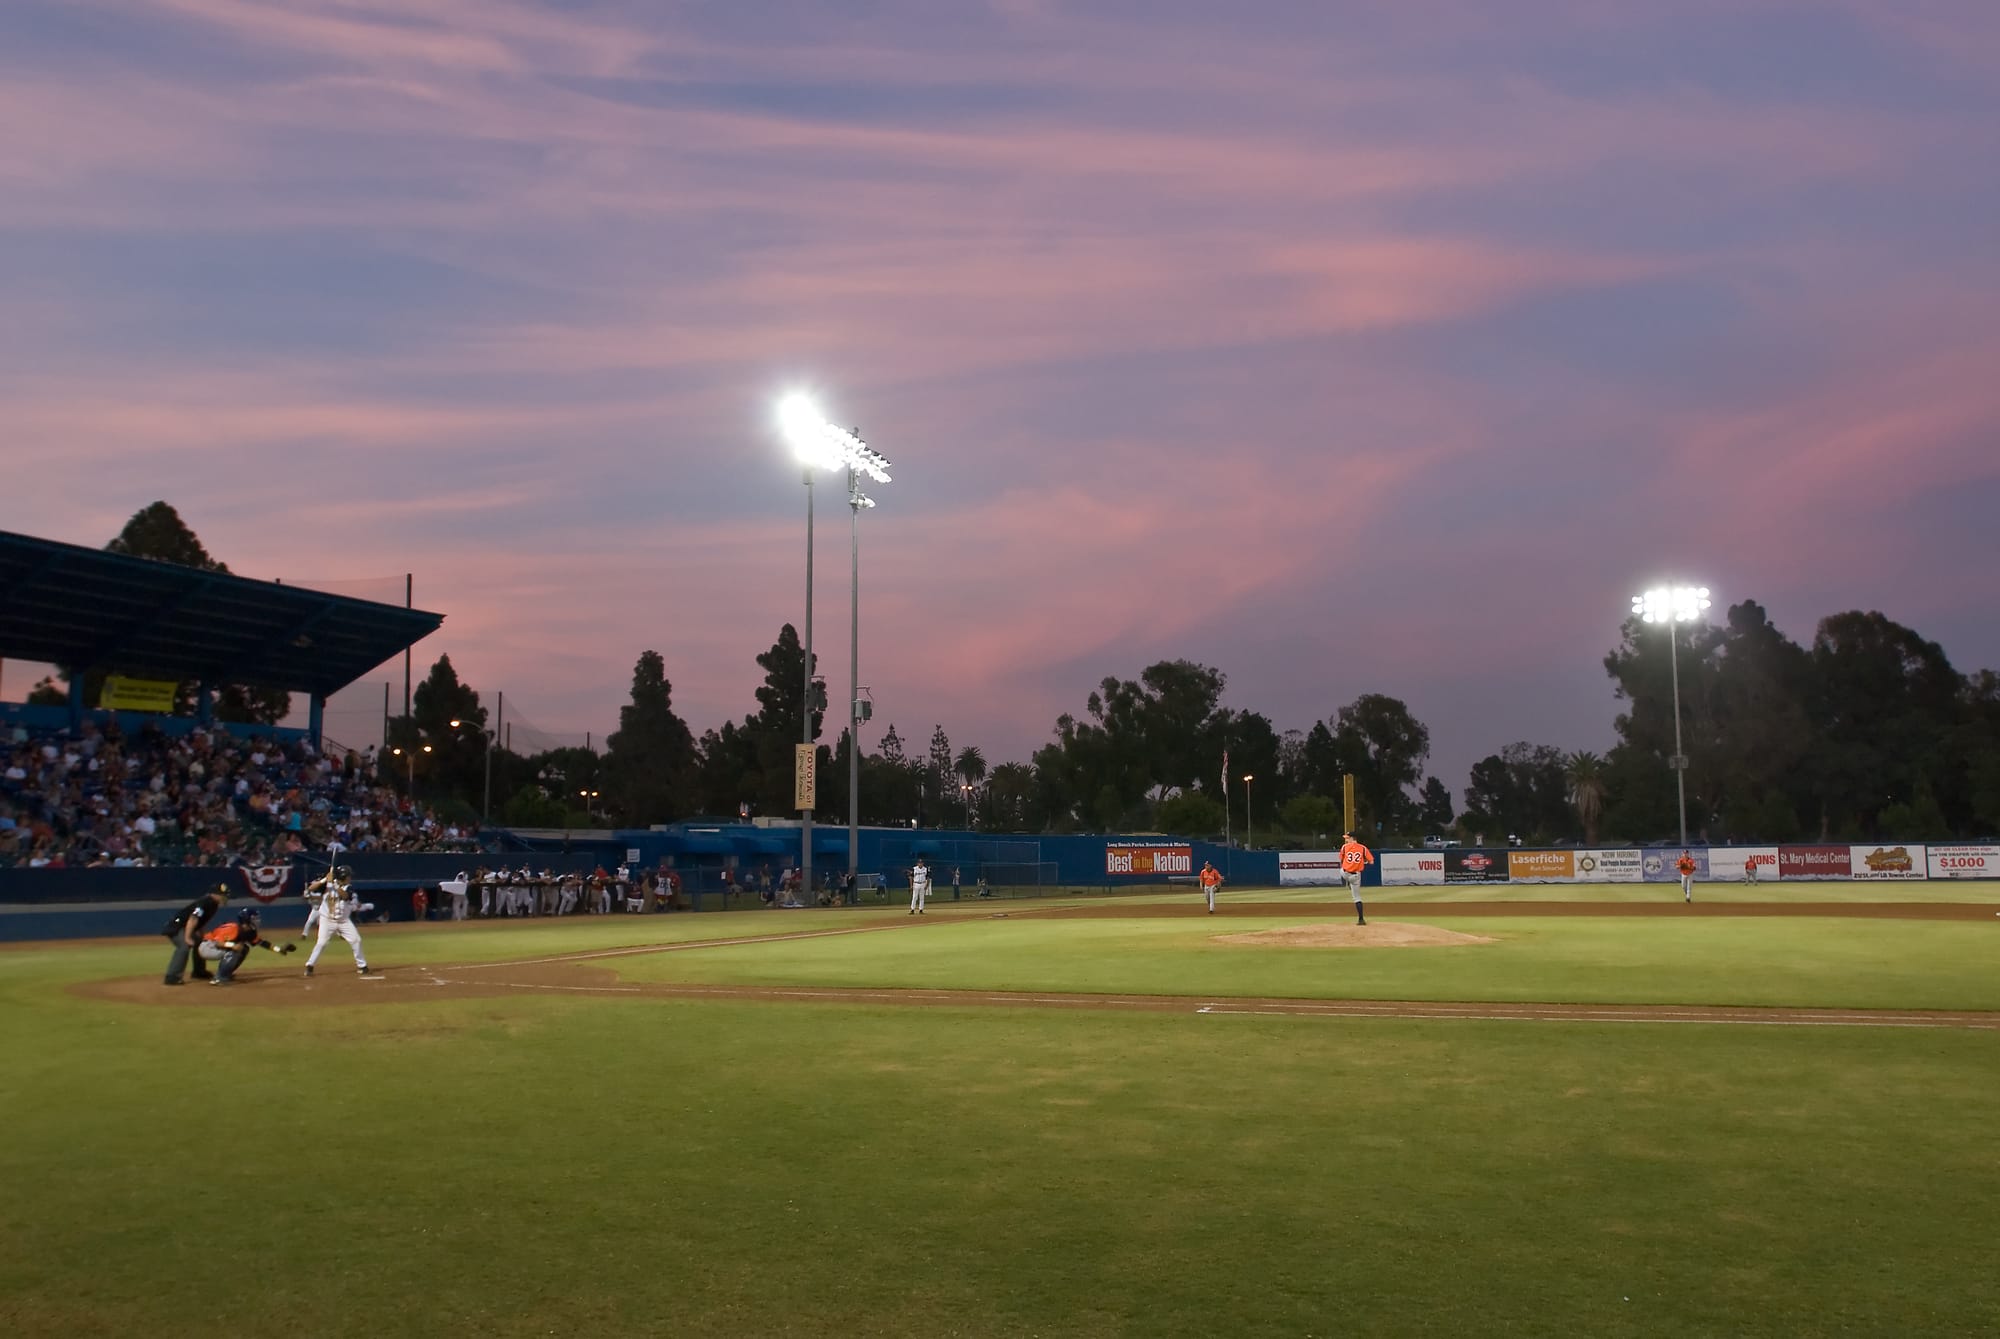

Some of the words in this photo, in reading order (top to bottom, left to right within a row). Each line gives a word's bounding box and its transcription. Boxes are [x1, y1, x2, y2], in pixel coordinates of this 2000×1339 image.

[1107, 852, 1133, 872] Best
[1153, 851, 1190, 872] Nation
[1347, 852, 1361, 863] 32
[1512, 854, 1566, 864] Laserfiche
[1749, 854, 1776, 864] VONS
[1780, 854, 1789, 864] St.
[1790, 853, 1804, 866] Mary
[1805, 852, 1829, 864] Medical
[1830, 852, 1850, 864] Center
[1940, 857, 1985, 868] $1000
[1418, 860, 1442, 871] VONS
